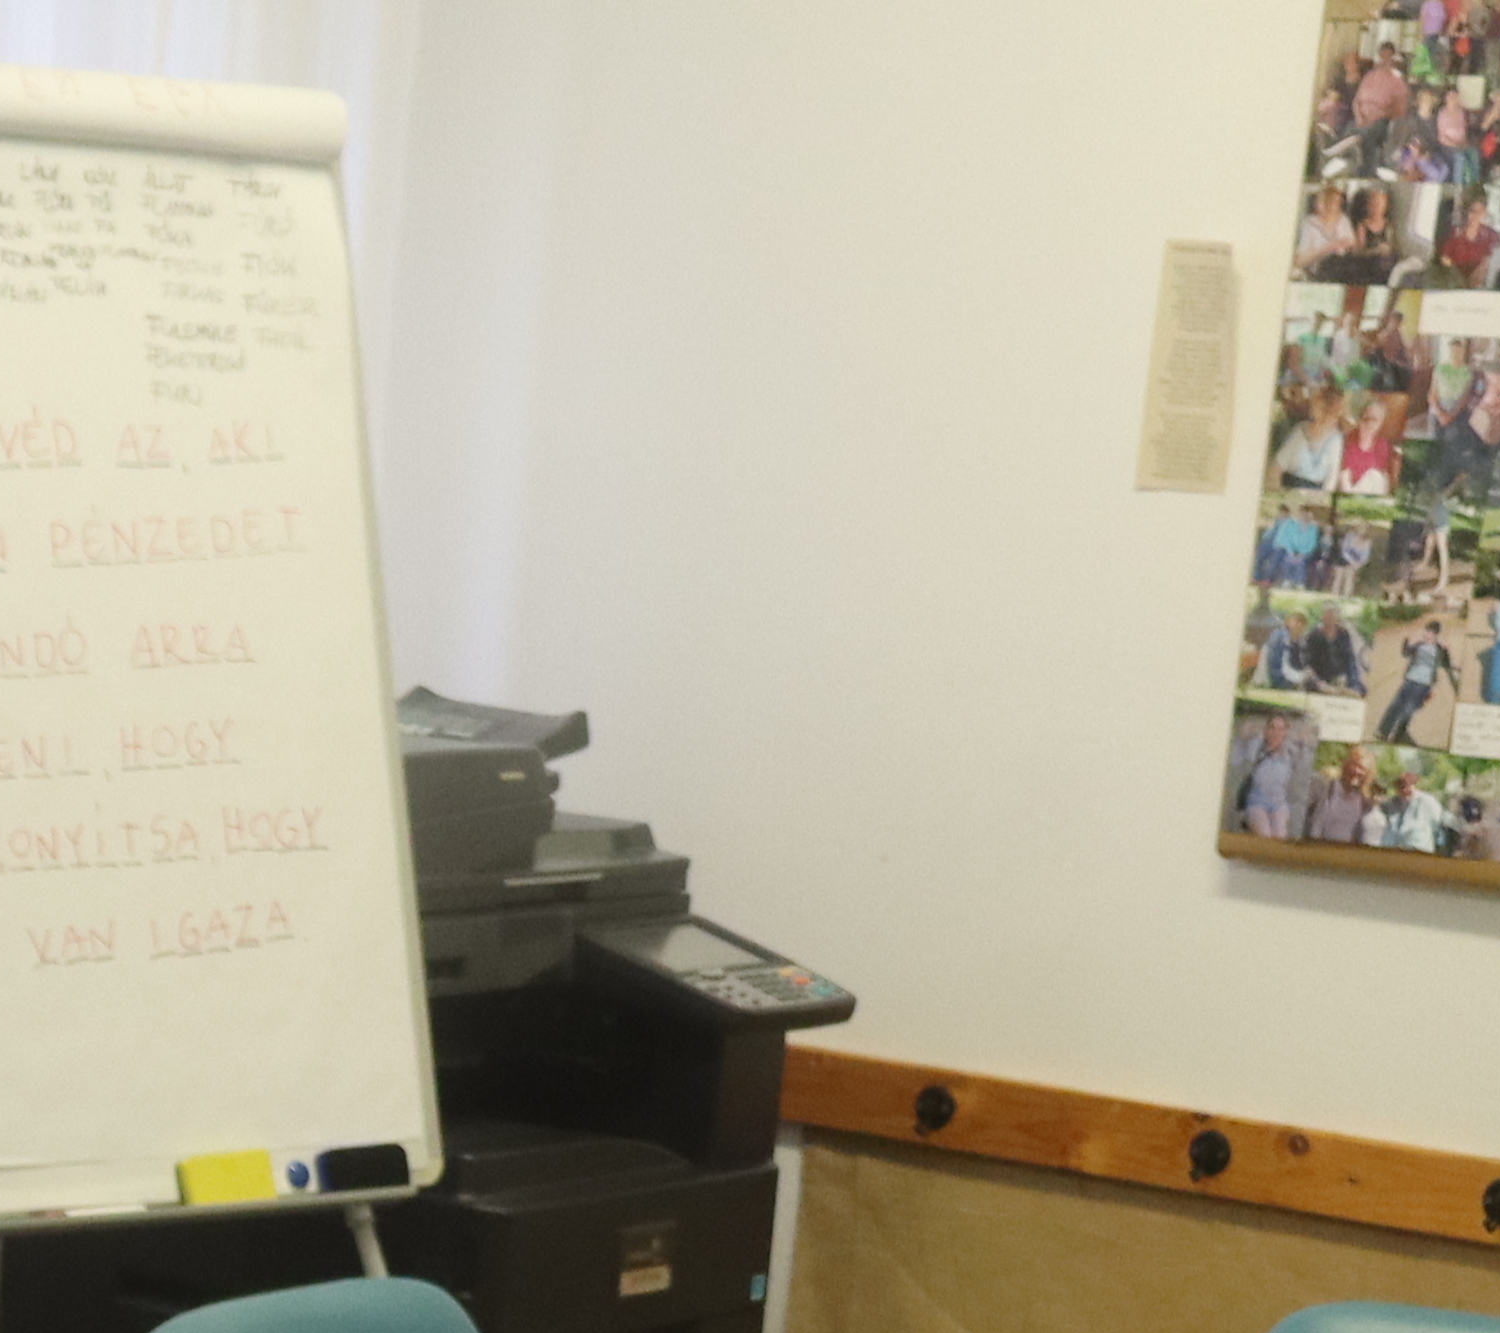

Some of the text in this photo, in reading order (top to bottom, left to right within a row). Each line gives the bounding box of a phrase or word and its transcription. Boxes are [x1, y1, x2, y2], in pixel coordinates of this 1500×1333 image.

[207, 417, 286, 461] AKI
[130, 622, 257, 669] ARRA
[119, 717, 242, 772] HOGY
[221, 805, 331, 853] HOGY
[26, 917, 117, 970] VAN
